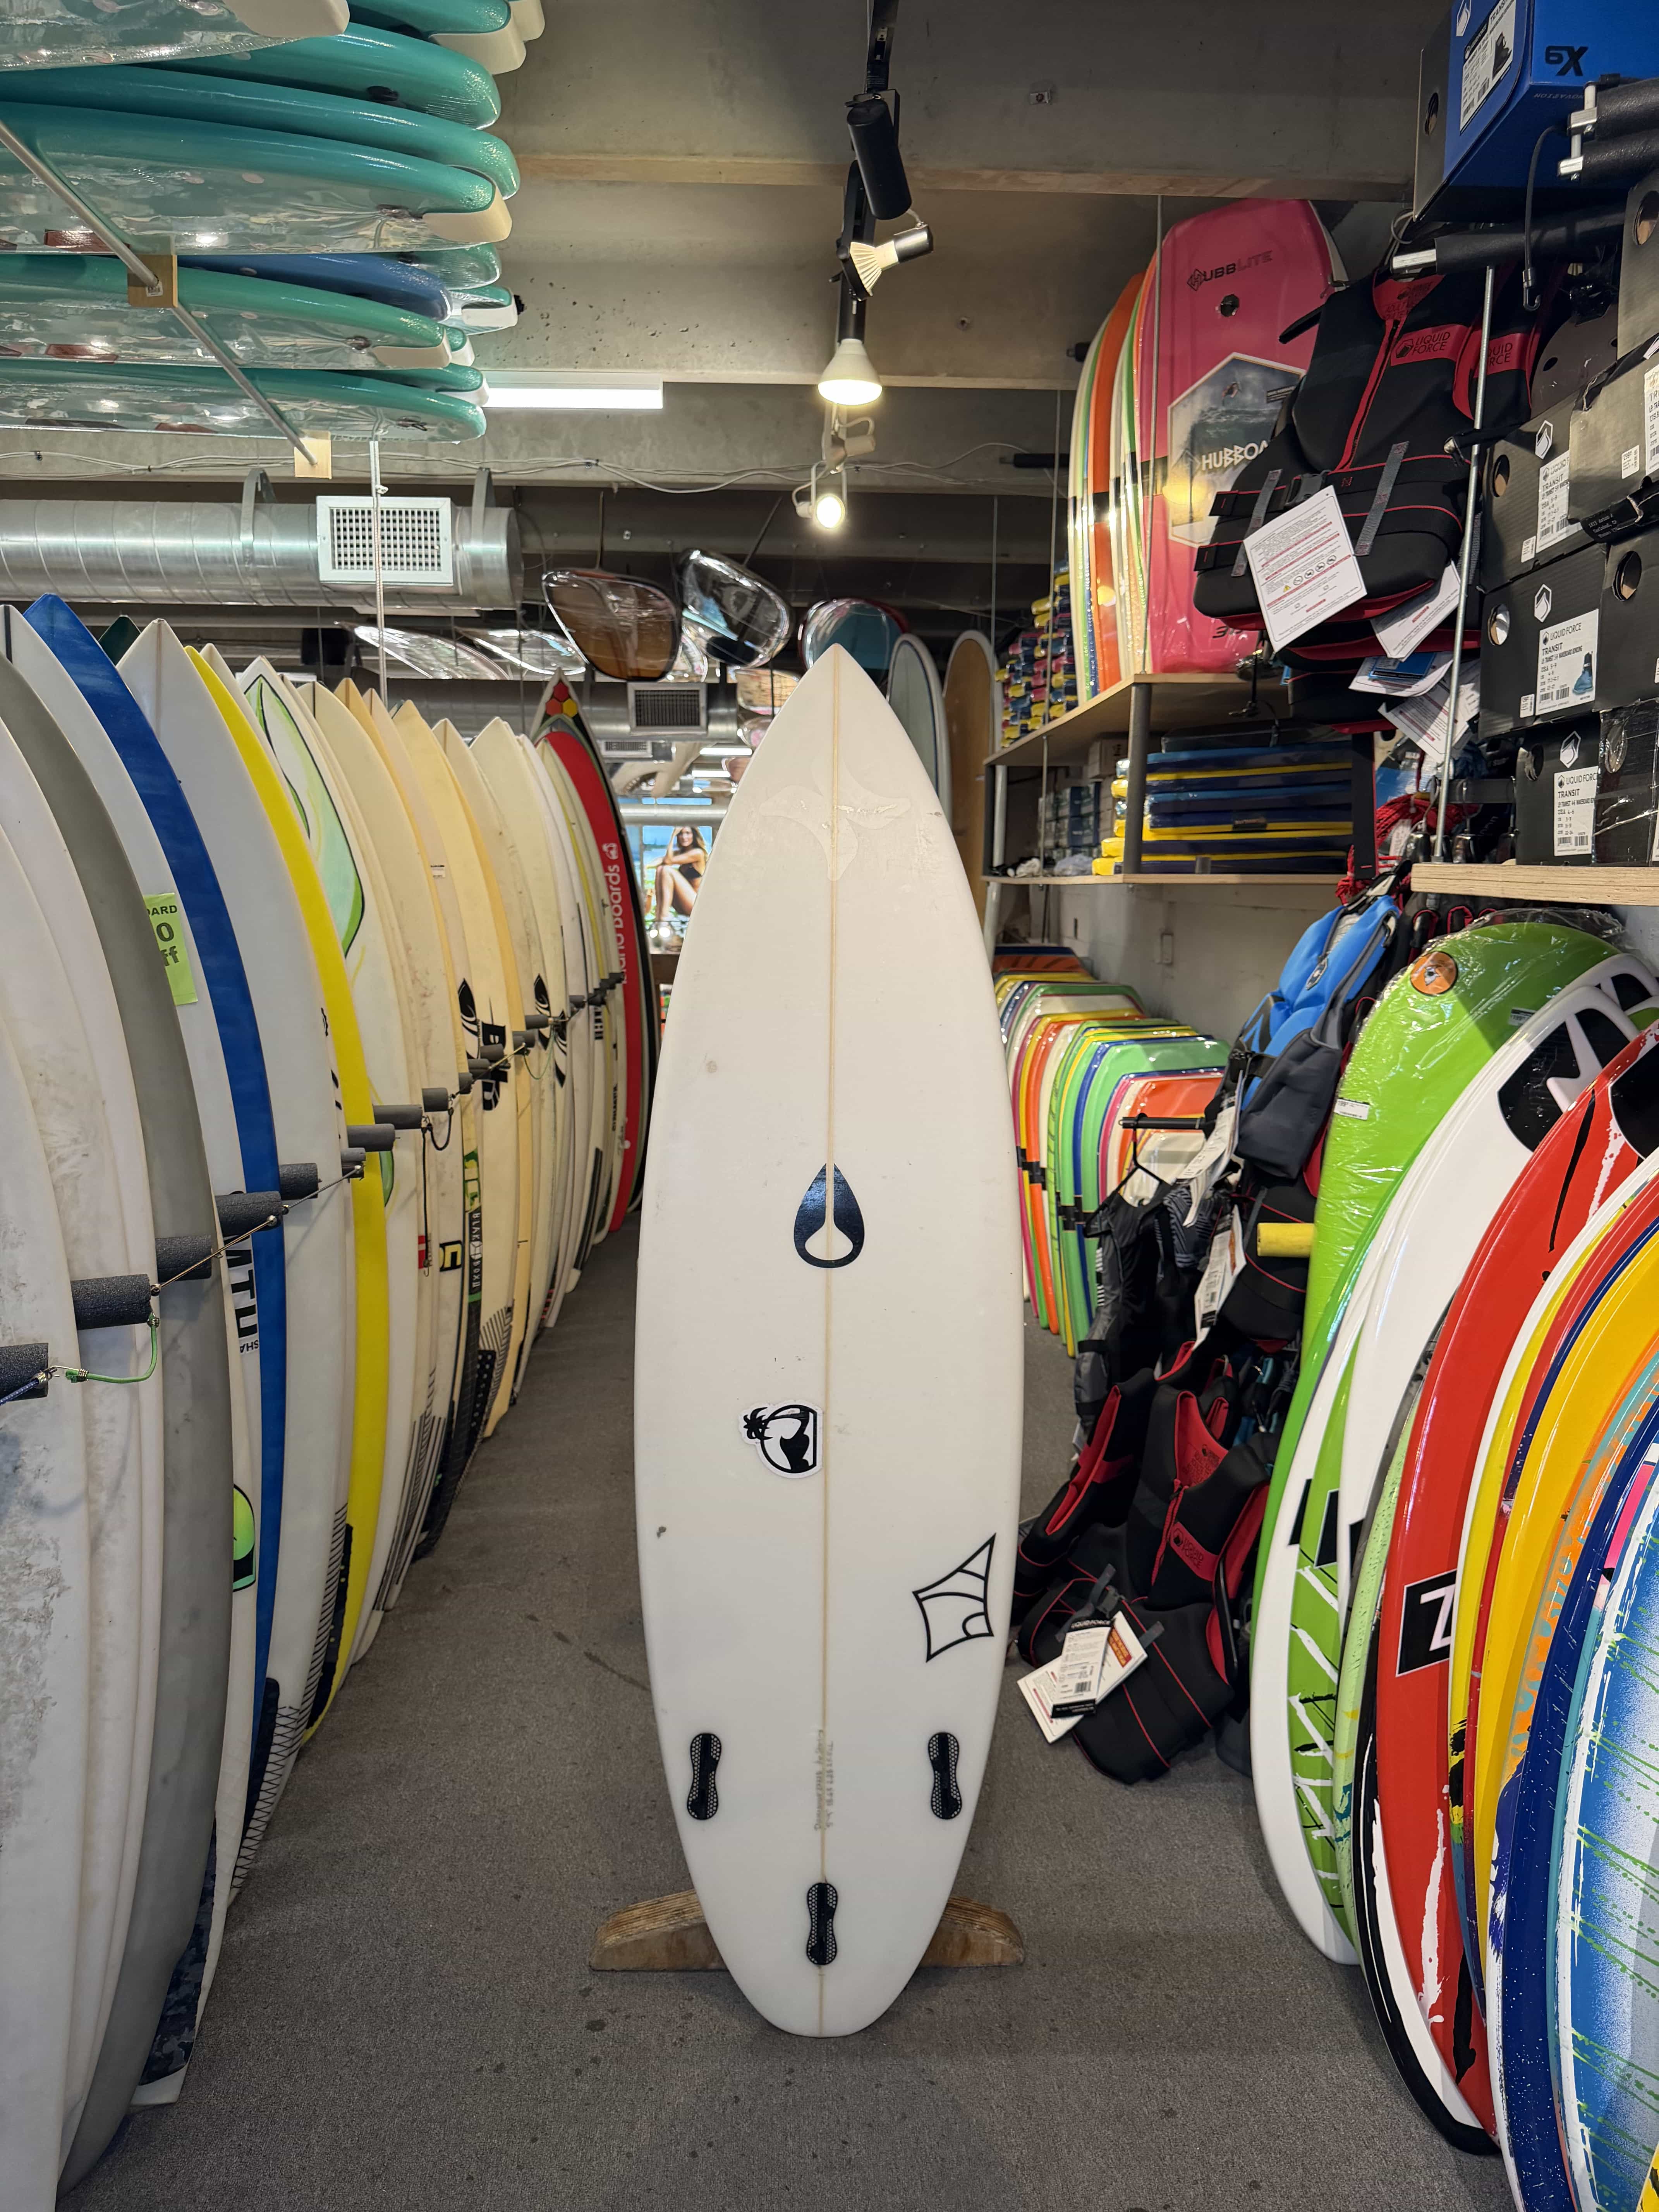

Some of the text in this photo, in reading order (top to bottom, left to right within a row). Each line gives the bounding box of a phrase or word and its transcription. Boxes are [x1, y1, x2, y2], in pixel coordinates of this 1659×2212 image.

[1416, 331, 1450, 345] LIQUID
[1413, 342, 1447, 355] FORCE
[1542, 472, 1563, 493] TRANSIT
[1550, 622, 1582, 641] LIQUID FORCE
[1542, 642, 1563, 656] TRANSIT
[1566, 775, 1582, 785] LIQUID
[1558, 788, 1580, 799] TRANSIT
[147, 905, 177, 916] ARD
